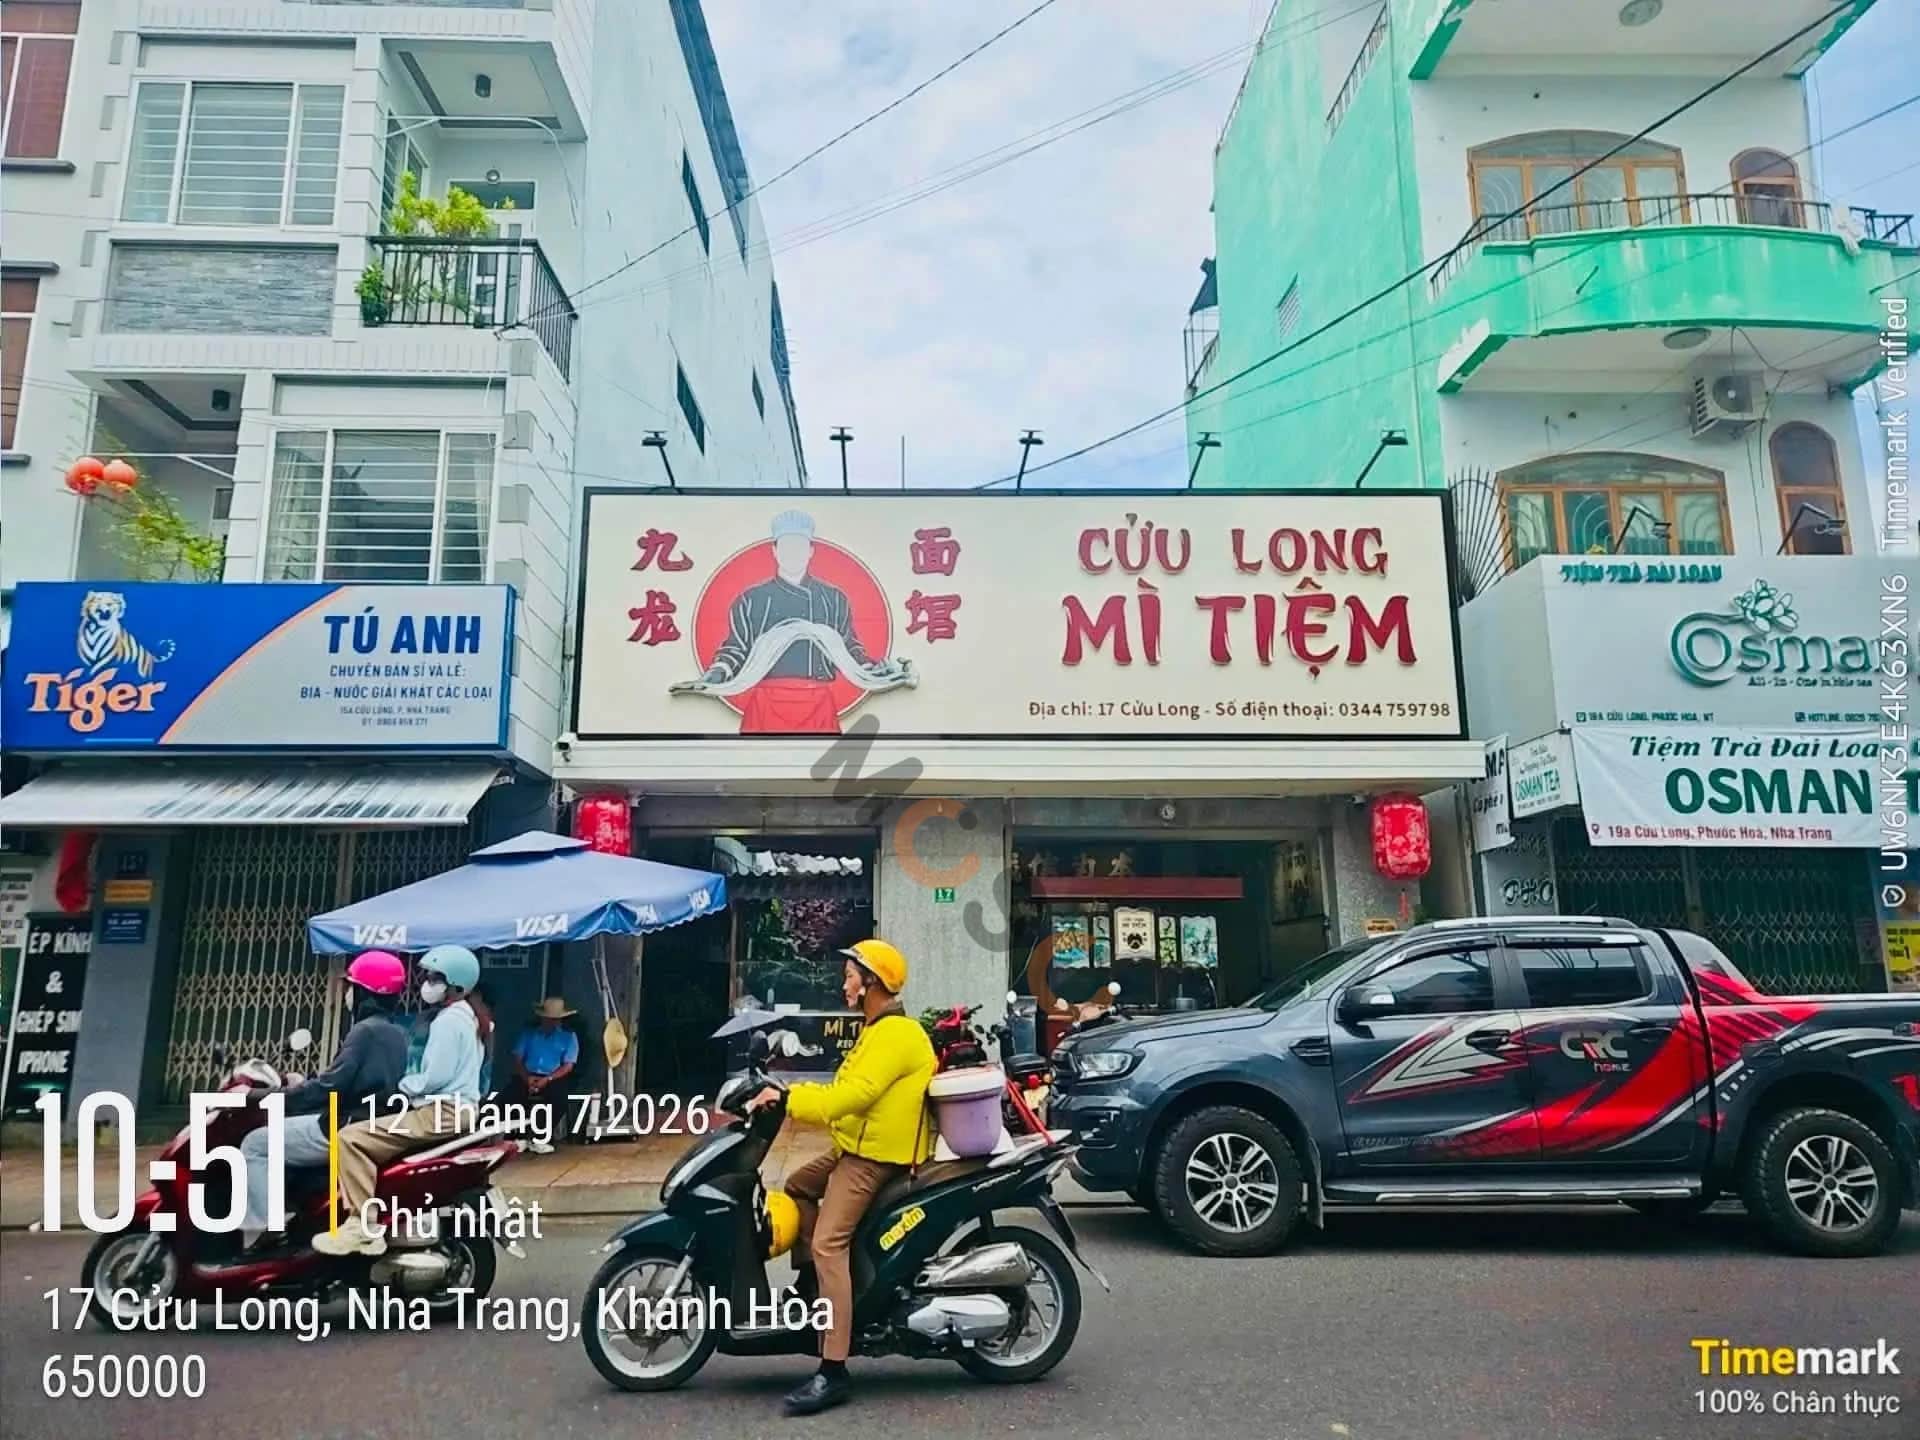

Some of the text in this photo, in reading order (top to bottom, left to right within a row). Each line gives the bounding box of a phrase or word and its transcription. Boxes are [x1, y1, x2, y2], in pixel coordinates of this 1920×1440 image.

[1078, 513, 1388, 576] CỬU LONG
[324, 605, 481, 654] TÚ ANH
[1062, 576, 1417, 680] MÌ TIỆM
[329, 661, 381, 678] CHUYÊN
[24, 667, 167, 732] Tiger
[300, 685, 321, 699] BIA
[464, 685, 493, 702] LOẠI
[1029, 702, 1056, 719] Địa
[1098, 702, 1114, 717] 17
[1120, 699, 1154, 717] Cửu
[1157, 701, 1200, 720] Long
[1215, 698, 1237, 717] Số
[1242, 701, 1278, 720] điện
[1283, 701, 1334, 720] thoại:
[1630, 735, 1700, 761] Tiệm
[1711, 735, 1763, 757] Trà
[1771, 736, 1820, 758] Đài
[1828, 738, 1885, 758] Loa
[1665, 767, 1872, 815] OSMAN
[1608, 825, 1631, 838] 19a
[1770, 826, 1795, 840] Nha
[1797, 826, 1833, 841] Trang
[937, 888, 953, 898] 17
[352, 923, 408, 946] VISA
[515, 912, 569, 938] VISA
[45, 970, 64, 994] &
[17, 1050, 71, 1074] IPHONE
[879, 1207, 926, 1251] maxim
